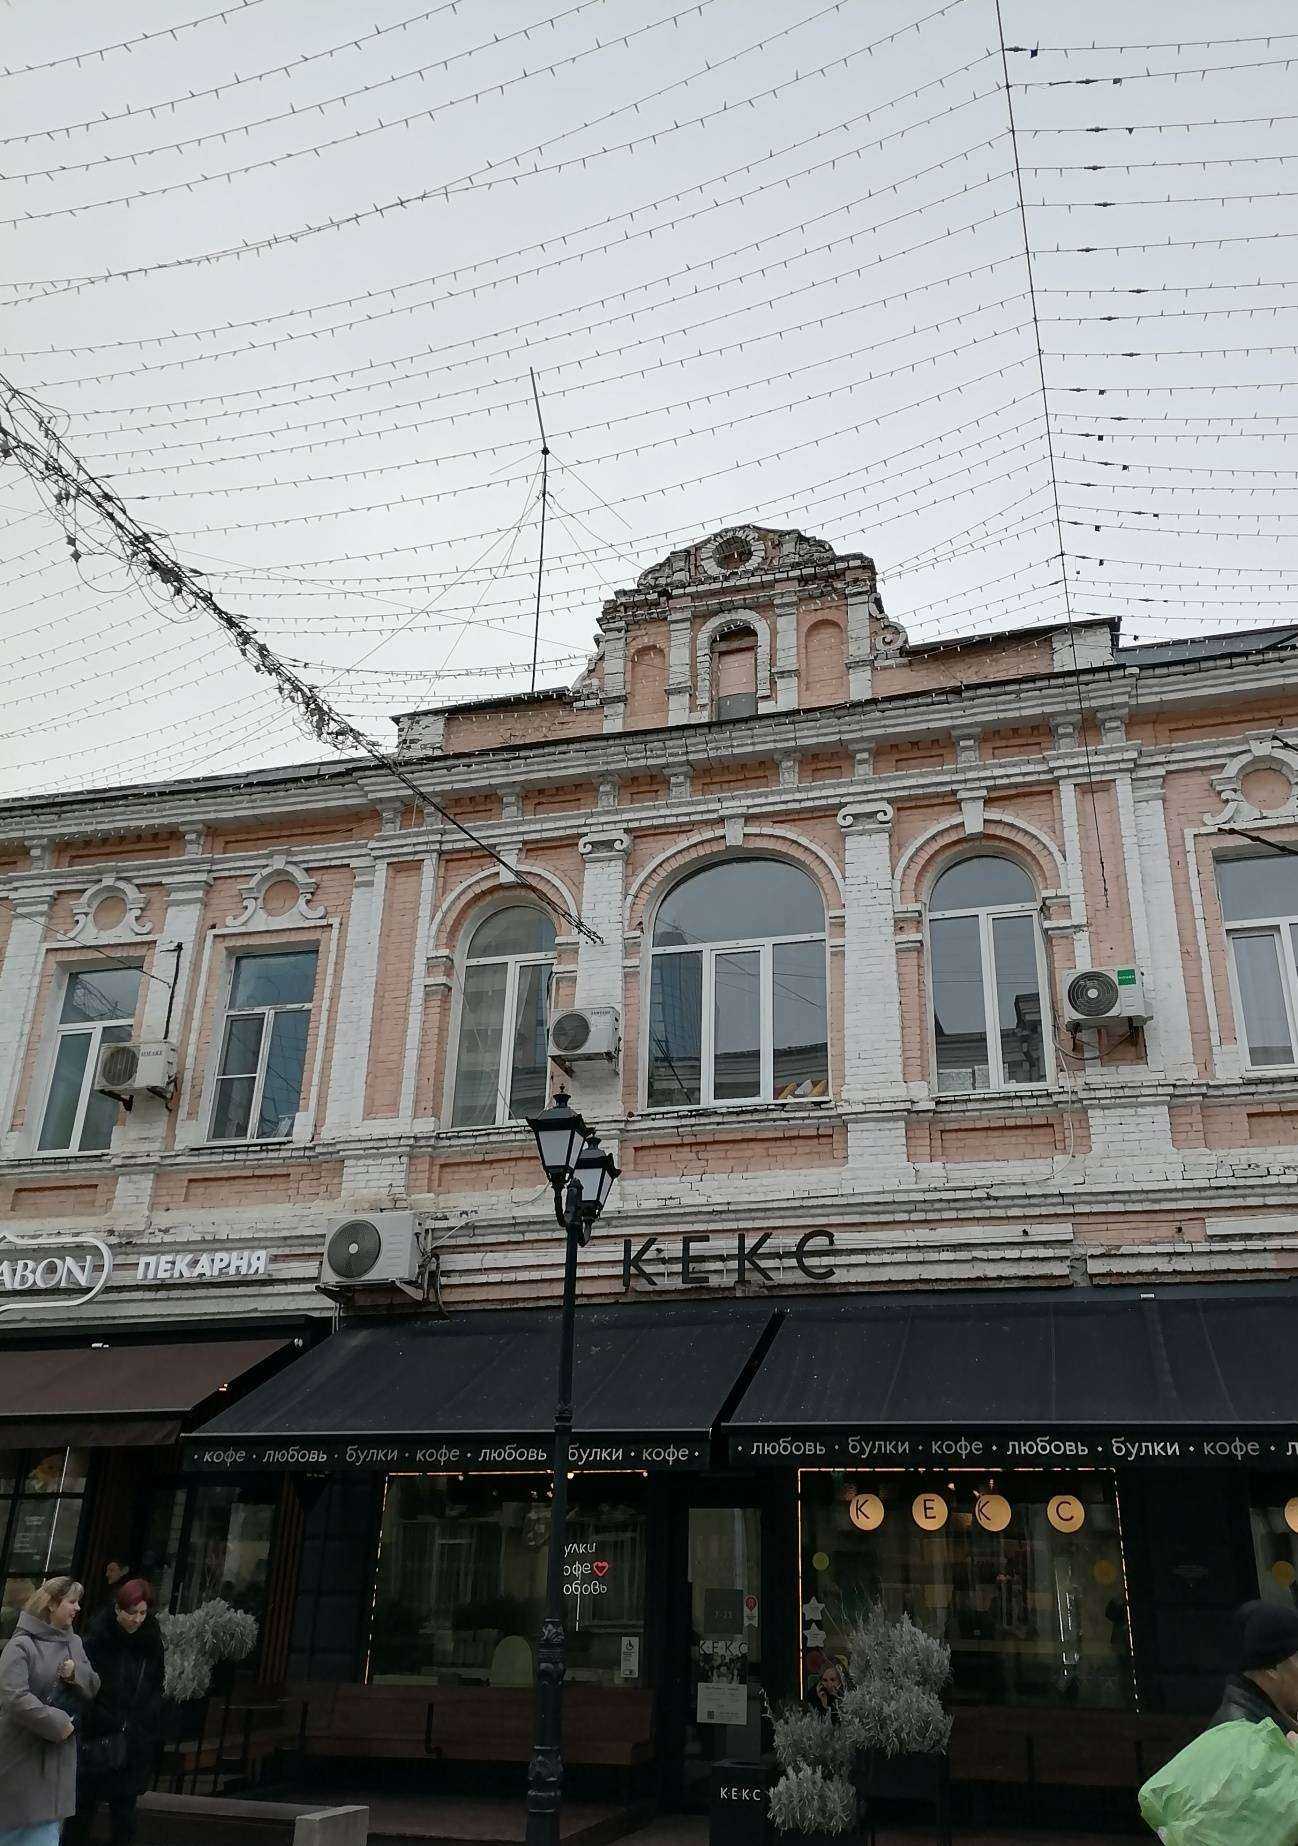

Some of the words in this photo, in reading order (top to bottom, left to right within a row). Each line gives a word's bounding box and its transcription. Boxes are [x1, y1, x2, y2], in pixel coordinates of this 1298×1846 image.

[137, 1250, 268, 1280] ПЕКАРНЯ
[622, 1229, 837, 1287] КЕКС
[203, 1446, 246, 1467] кофе
[262, 1445, 327, 1463] любовь
[345, 1445, 398, 1466] булки
[416, 1444, 460, 1466] кофе
[478, 1443, 548, 1462] любовь
[568, 1442, 623, 1465] булки
[642, 1444, 689, 1466] кофе
[750, 1437, 826, 1455] любовь
[848, 1435, 910, 1459] булки
[931, 1436, 984, 1459] кофе
[1006, 1436, 1089, 1455] любовь
[1111, 1436, 1180, 1461] булки
[1203, 1436, 1260, 1461] кофе
